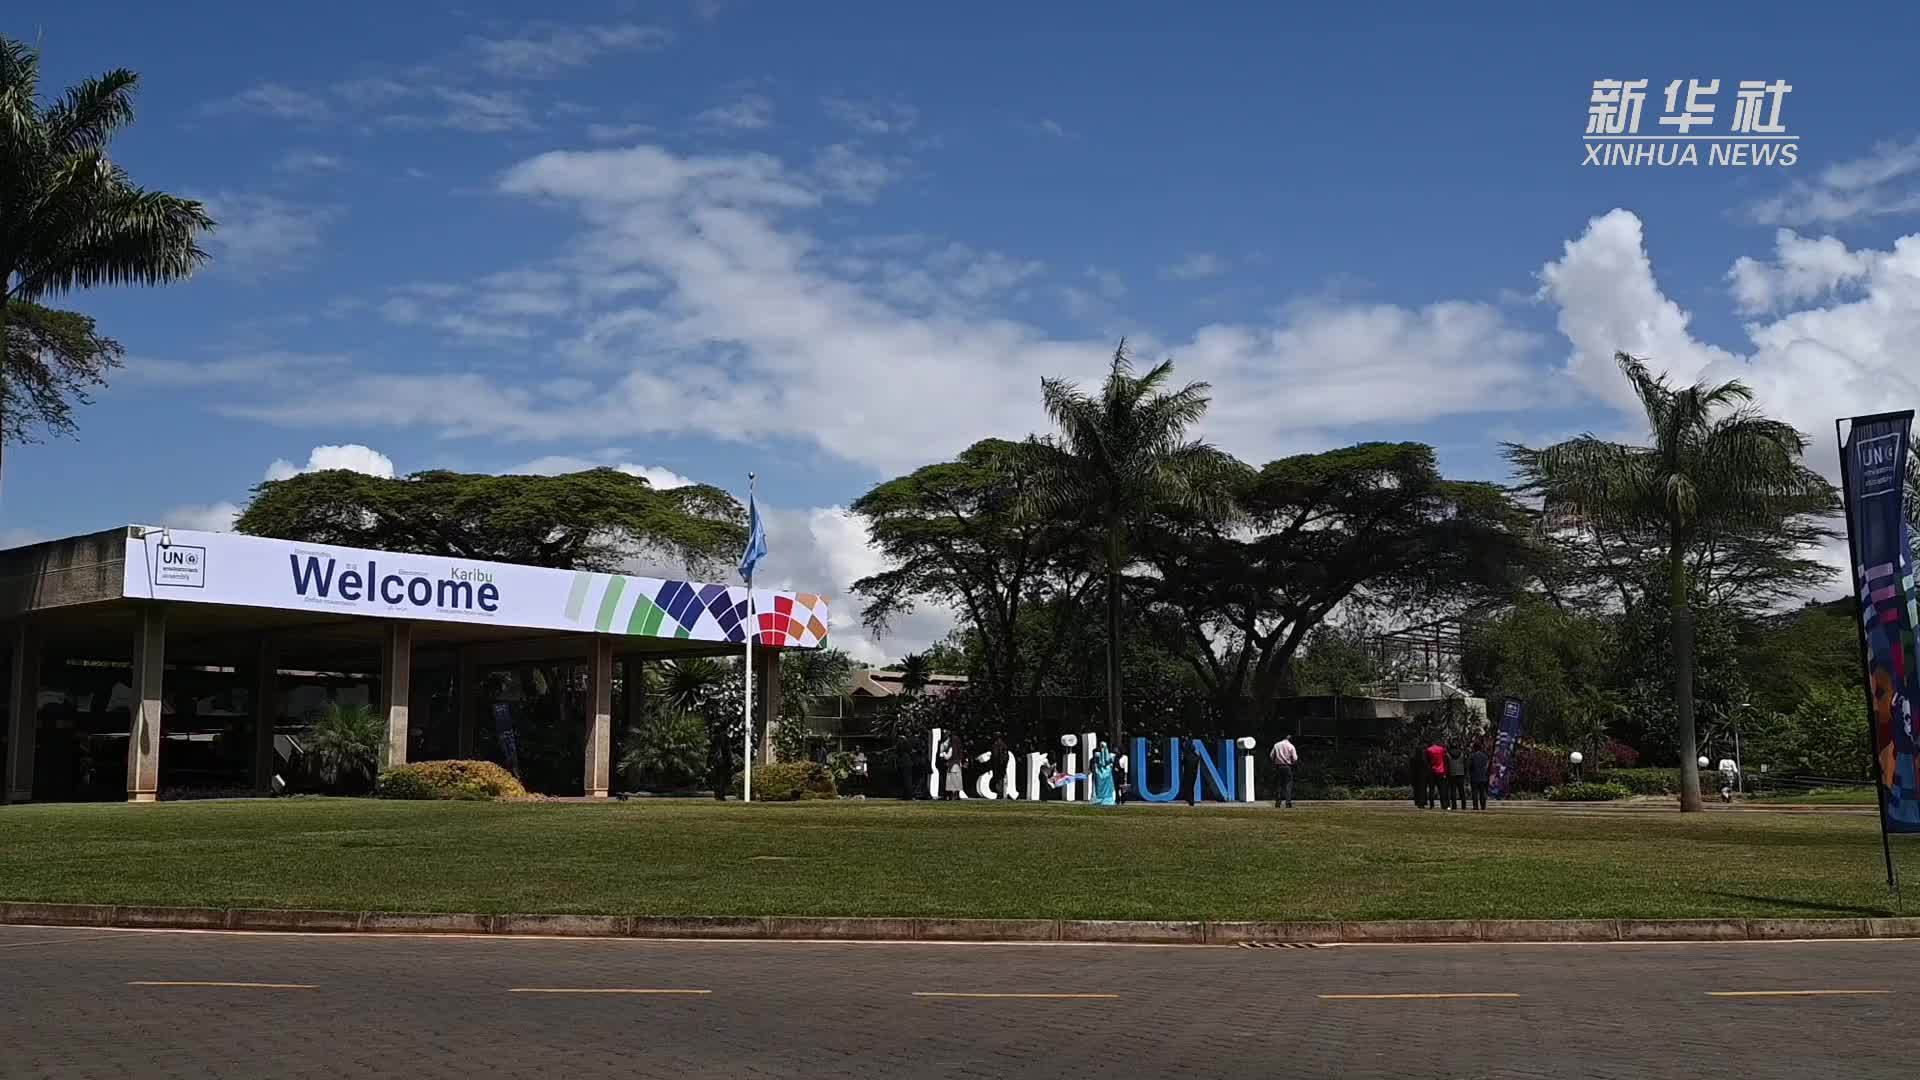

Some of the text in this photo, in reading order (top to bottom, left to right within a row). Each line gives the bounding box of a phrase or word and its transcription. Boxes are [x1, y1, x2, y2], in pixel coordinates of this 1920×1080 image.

[163, 551, 183, 564] UN
[290, 554, 499, 612] Welcome
[451, 567, 493, 583] Karibu
